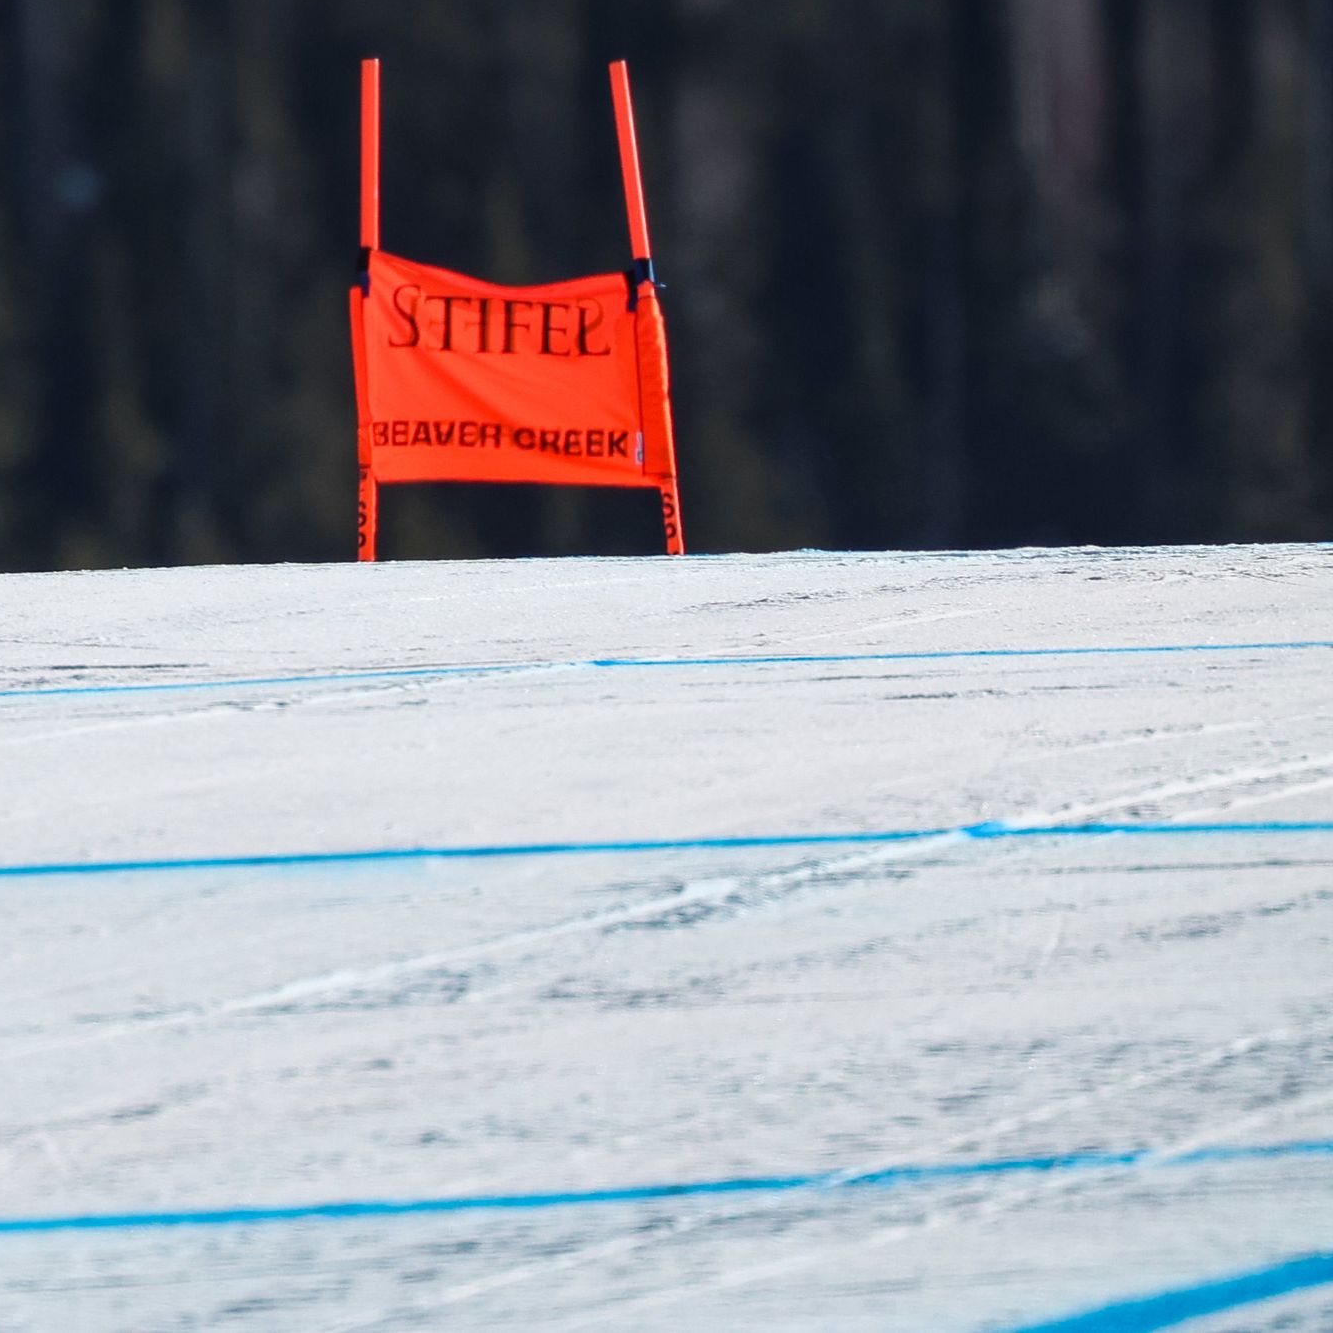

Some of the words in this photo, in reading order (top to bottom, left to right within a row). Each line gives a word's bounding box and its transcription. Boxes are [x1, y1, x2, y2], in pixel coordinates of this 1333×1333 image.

[387, 284, 611, 357] STIFEL
[372, 420, 502, 450] BEAVER
[513, 427, 630, 459] CREEK
